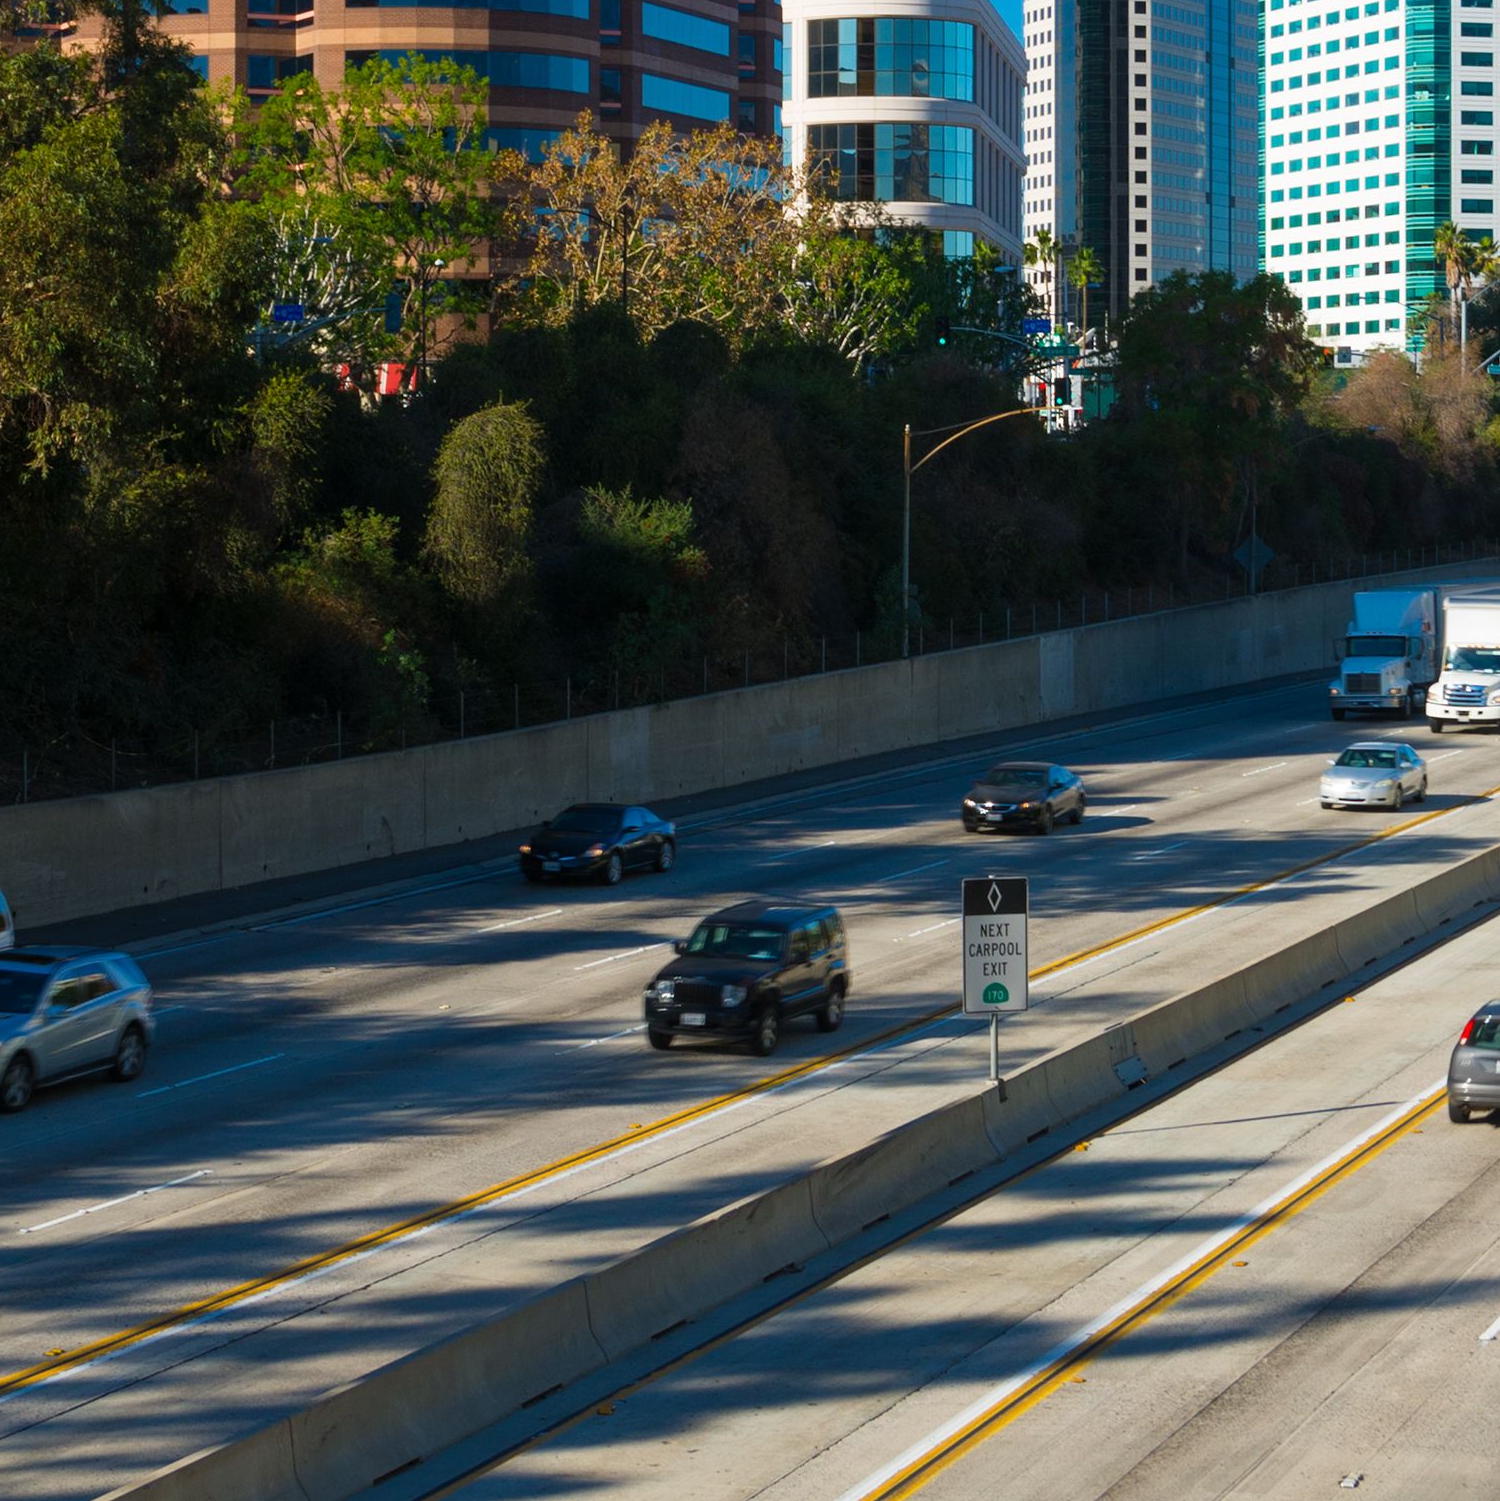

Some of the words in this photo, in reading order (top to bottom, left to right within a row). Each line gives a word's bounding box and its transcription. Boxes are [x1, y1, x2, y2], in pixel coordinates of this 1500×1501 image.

[980, 923, 1010, 938] NEXT
[968, 942, 1023, 958] CARPOOL
[982, 961, 1008, 977] EXIT
[987, 990, 1005, 1001] 170
